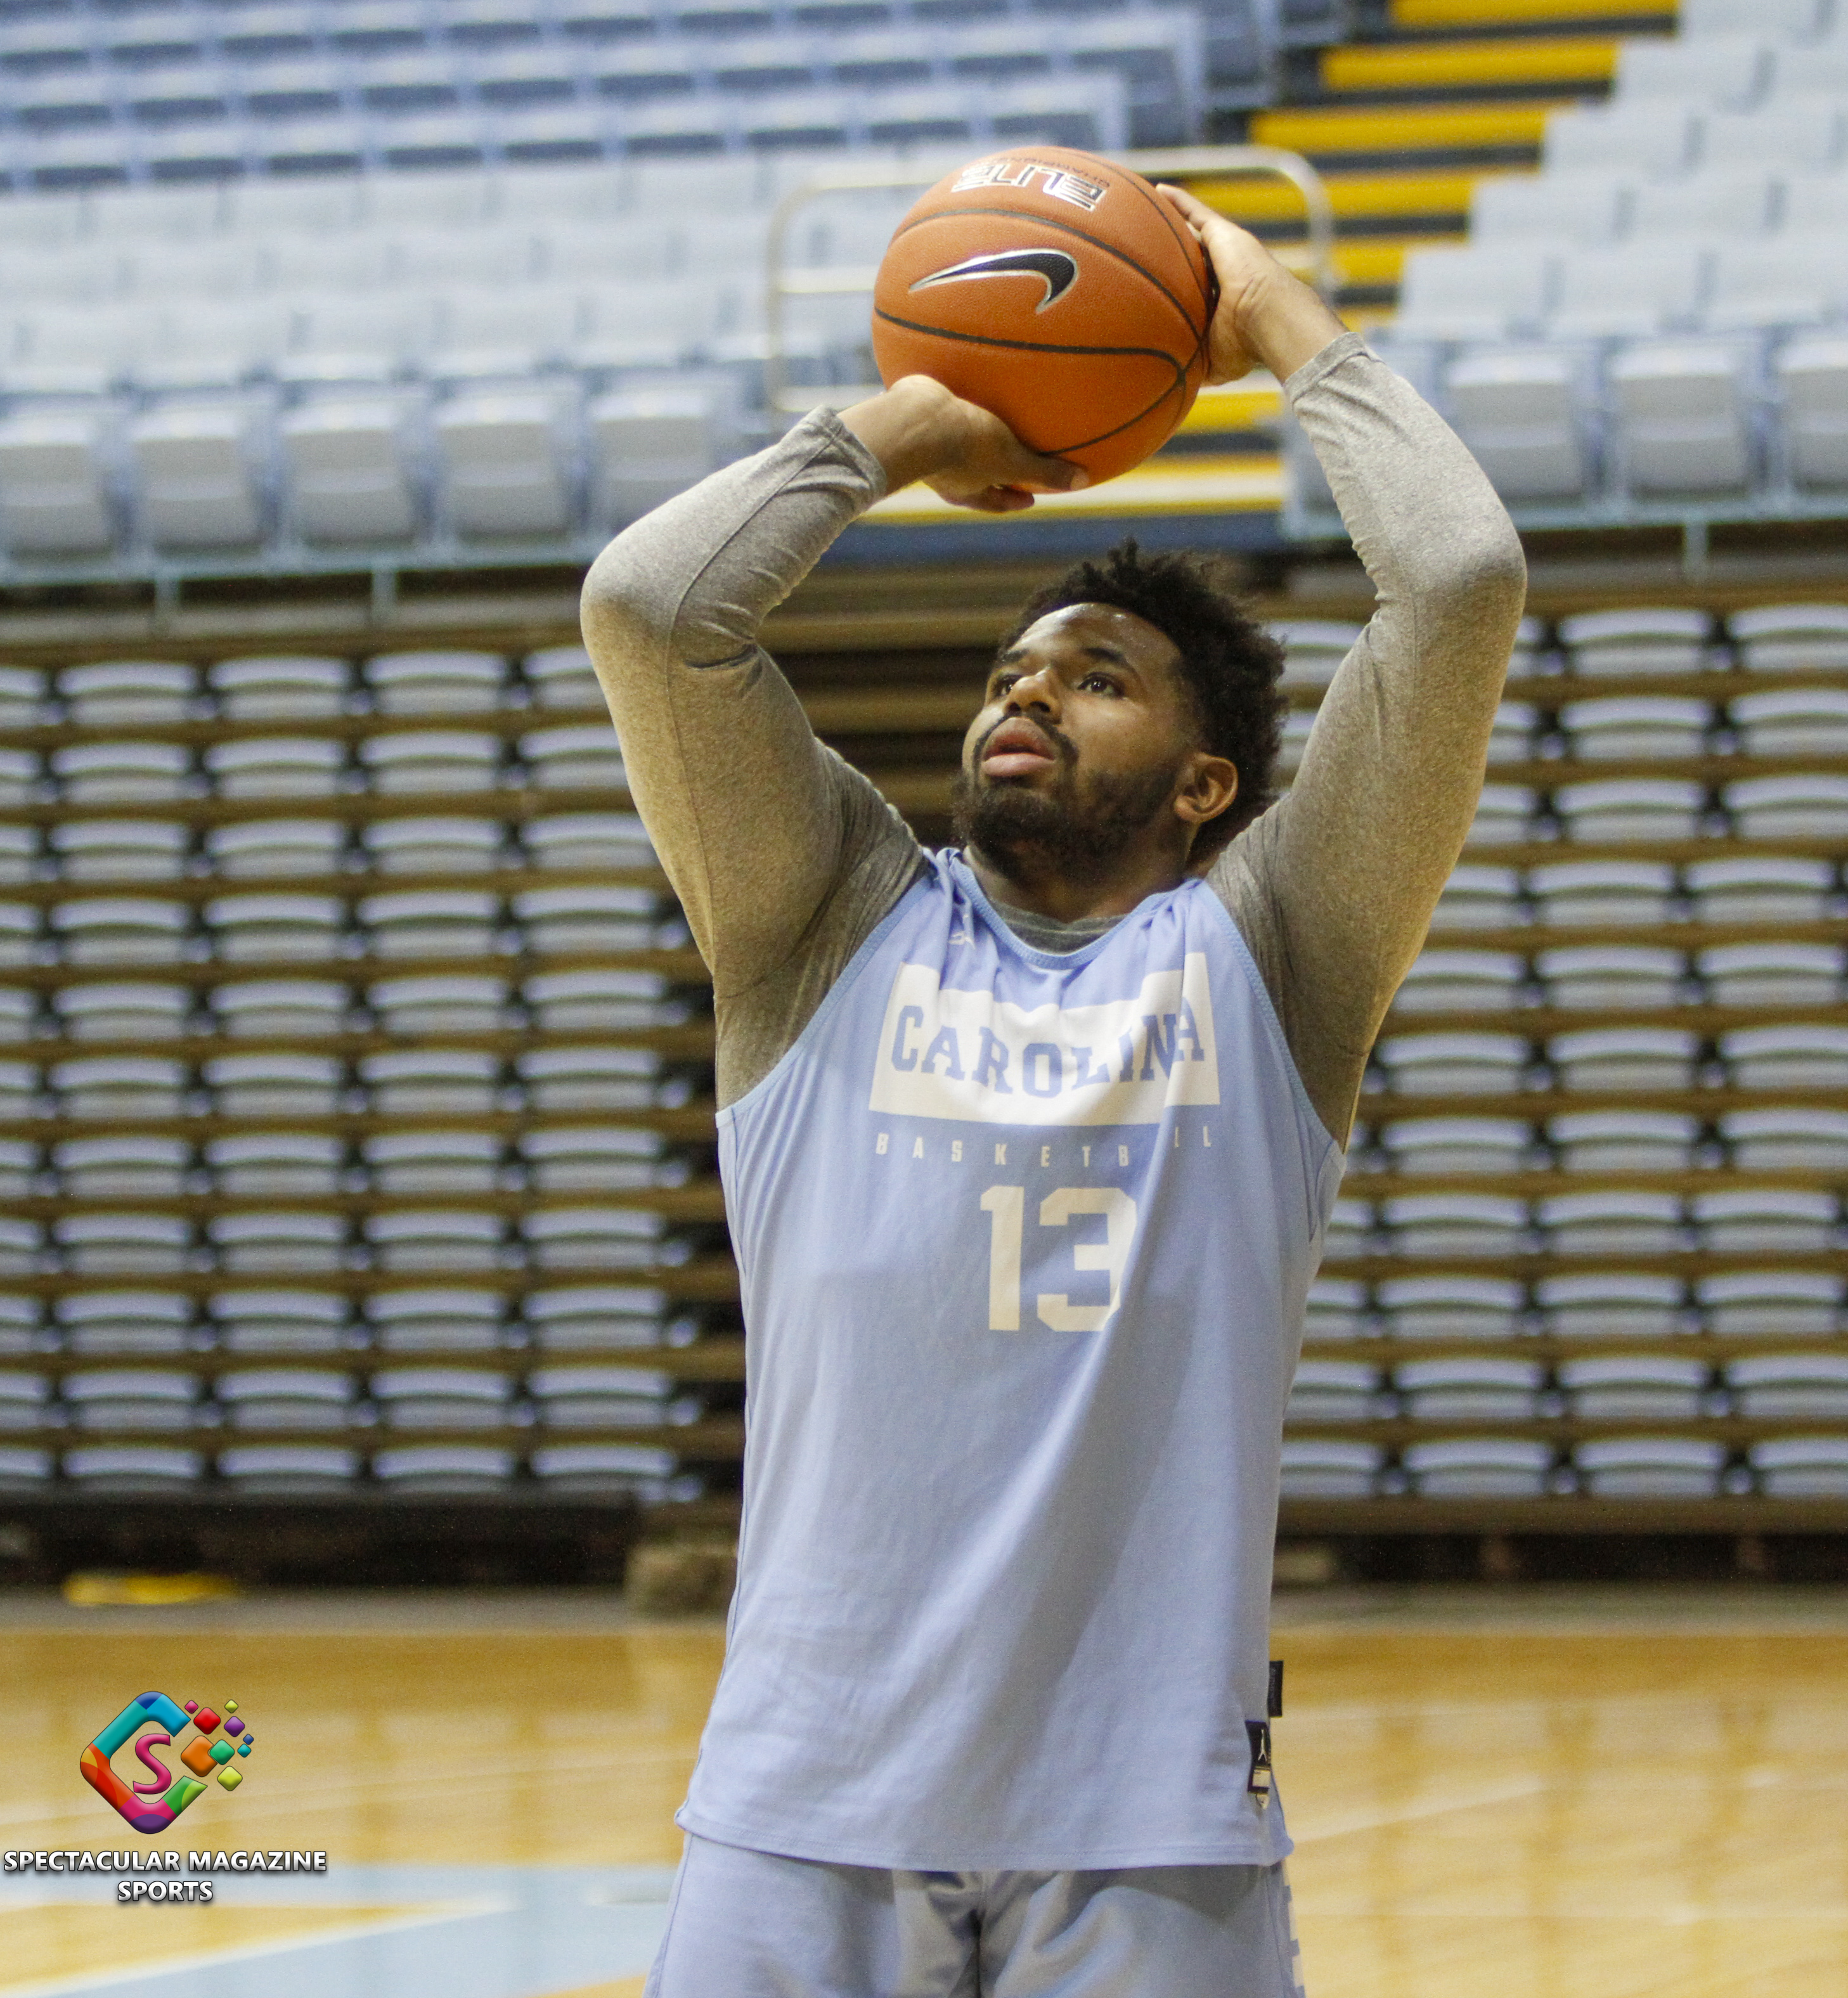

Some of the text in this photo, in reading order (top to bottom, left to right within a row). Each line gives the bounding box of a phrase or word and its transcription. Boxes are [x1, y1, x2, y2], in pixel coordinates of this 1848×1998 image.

[950, 163, 1108, 212] ELITE
[890, 996, 1206, 1099] CAROLINA
[979, 1185, 1137, 1332] 13
